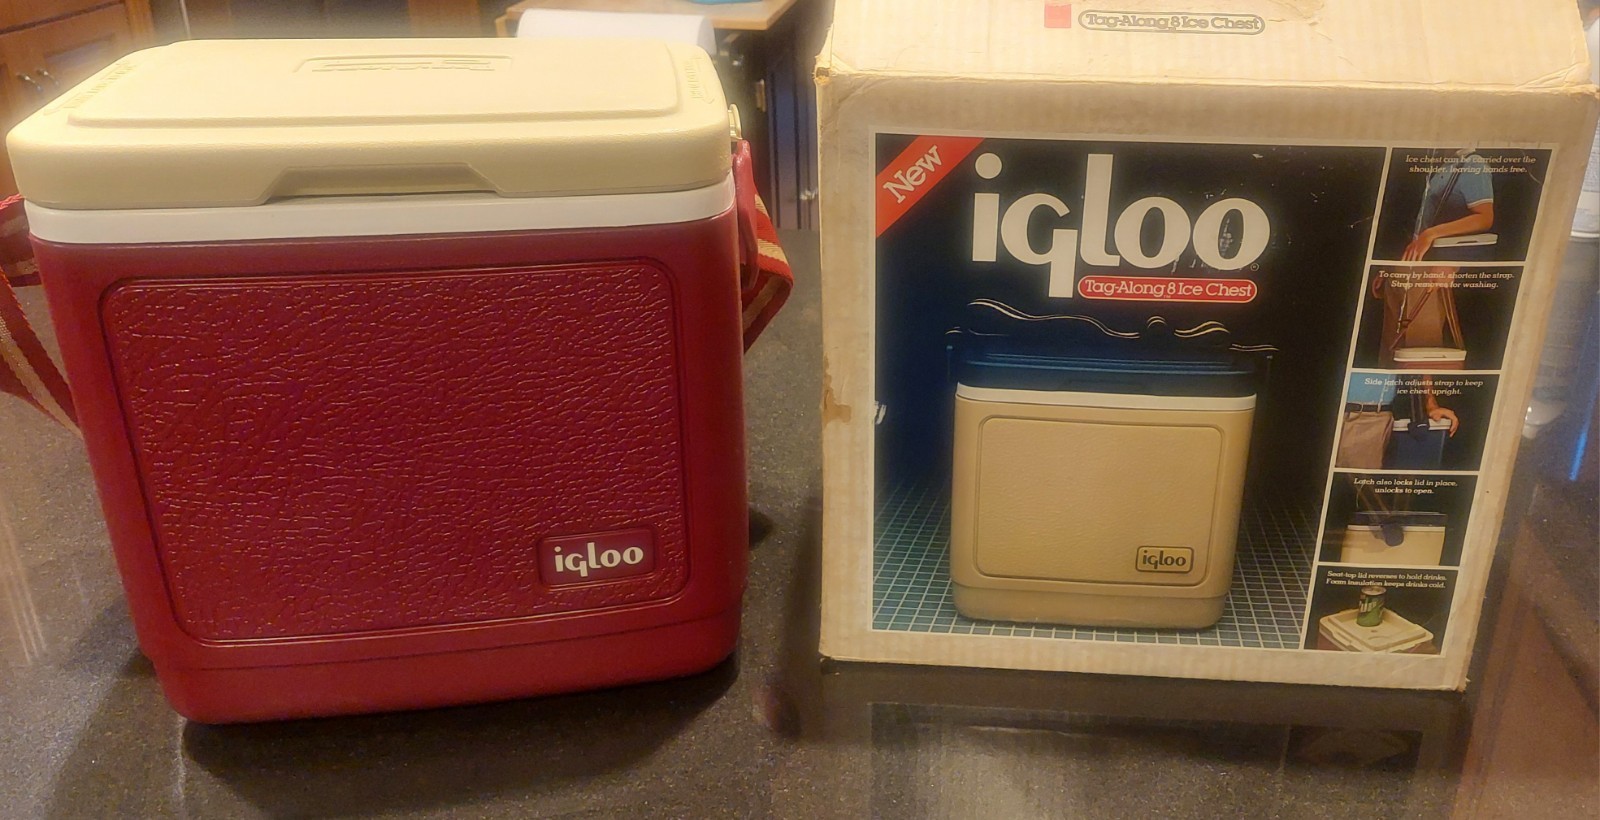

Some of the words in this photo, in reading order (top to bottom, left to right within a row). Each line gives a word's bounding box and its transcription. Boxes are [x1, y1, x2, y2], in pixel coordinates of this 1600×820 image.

[1086, 13, 1170, 29] Tag-Along
[1170, 16, 1180, 28] 8
[1181, 16, 1209, 28] Ice
[1211, 17, 1260, 30] Chest
[1420, 155, 1442, 163] chest
[882, 143, 944, 204] New
[1450, 166, 1480, 174] leaving
[972, 153, 1270, 298] igloo
[1412, 271, 1422, 279] by
[1448, 271, 1478, 279] shorten
[1085, 279, 1164, 296] Tag-Along
[1167, 282, 1175, 294] 8
[1178, 282, 1203, 295] Ice
[1206, 283, 1251, 297] Chest
[1391, 280, 1413, 289] Strap
[1405, 379, 1433, 387] adjusts
[1465, 379, 1483, 387] keep
[554, 542, 643, 577] igloo
[1143, 550, 1186, 569] igloo
[1328, 571, 1356, 579] Seat-top
[1384, 580, 1404, 588] keeps
